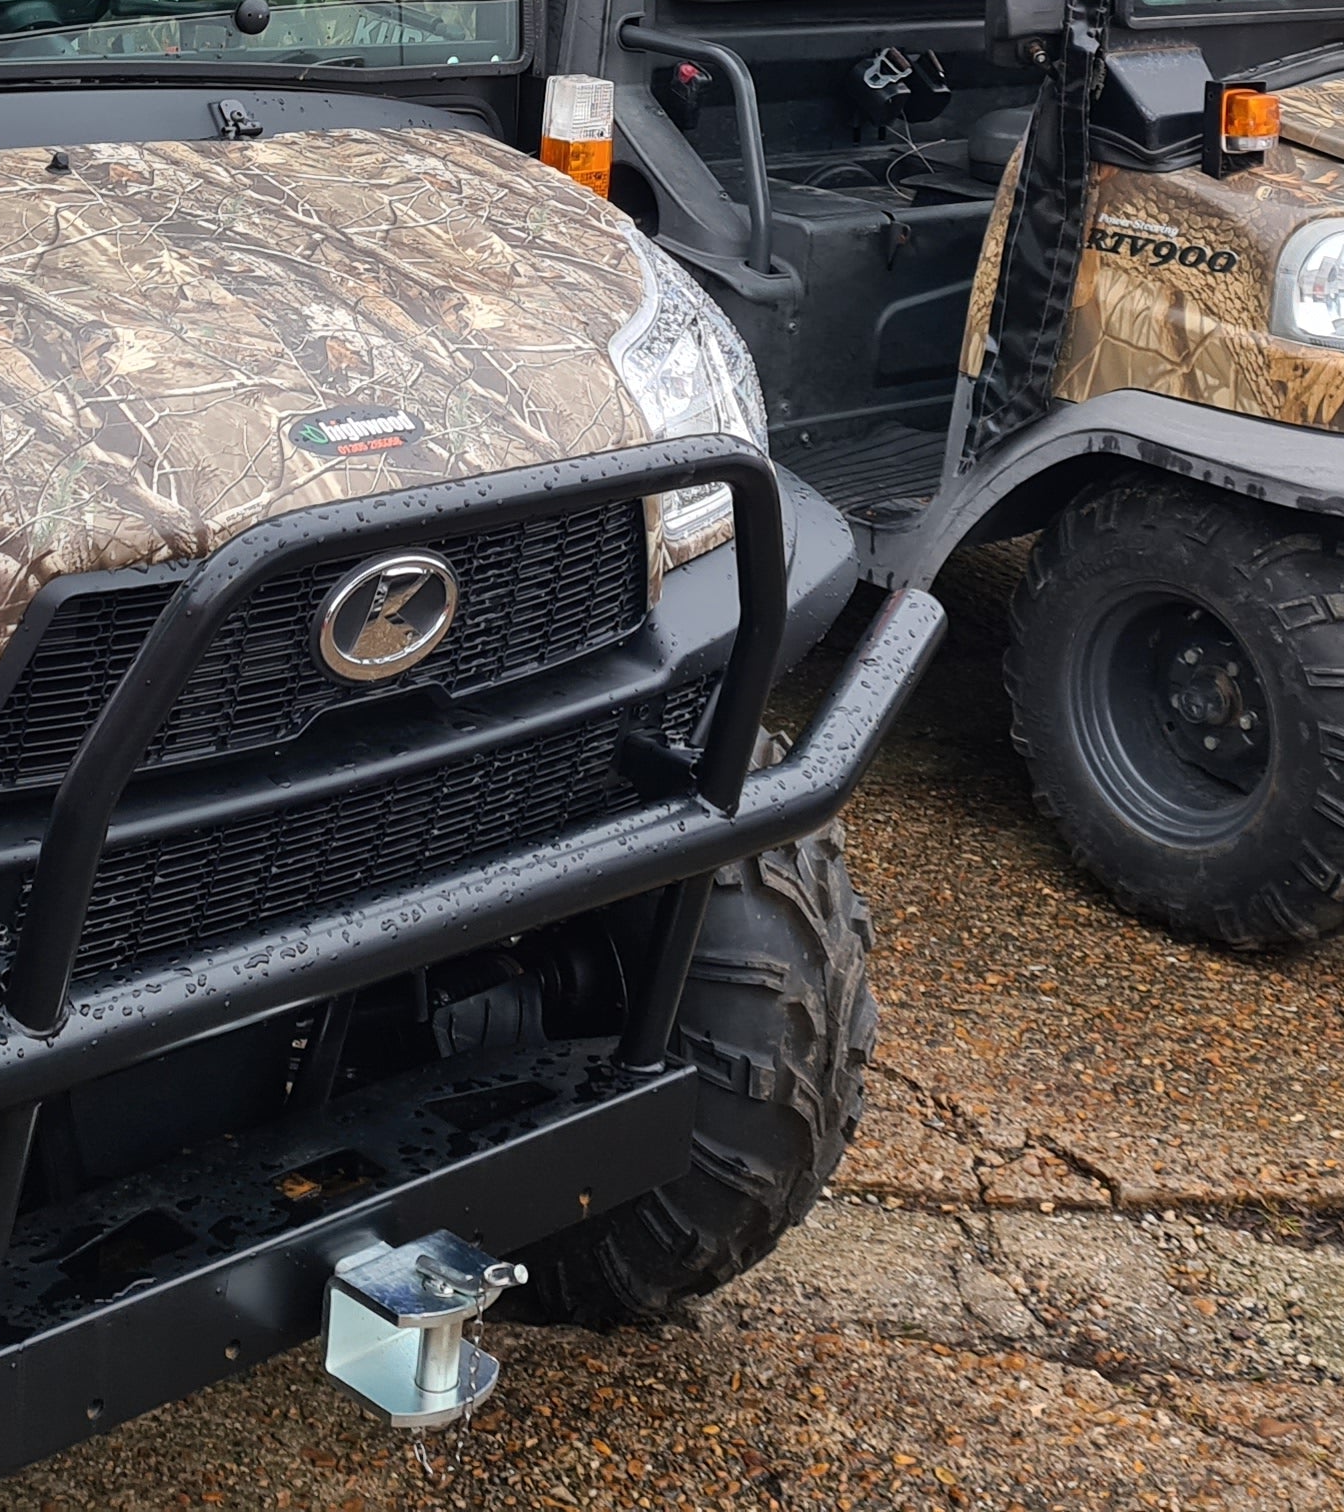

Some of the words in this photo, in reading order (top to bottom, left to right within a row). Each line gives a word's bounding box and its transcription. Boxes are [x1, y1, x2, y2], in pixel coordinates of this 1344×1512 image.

[1098, 213, 1133, 229] Power
[1133, 219, 1180, 238] Steering
[1086, 228, 1238, 273] RTV900
[318, 410, 416, 442] highwood
